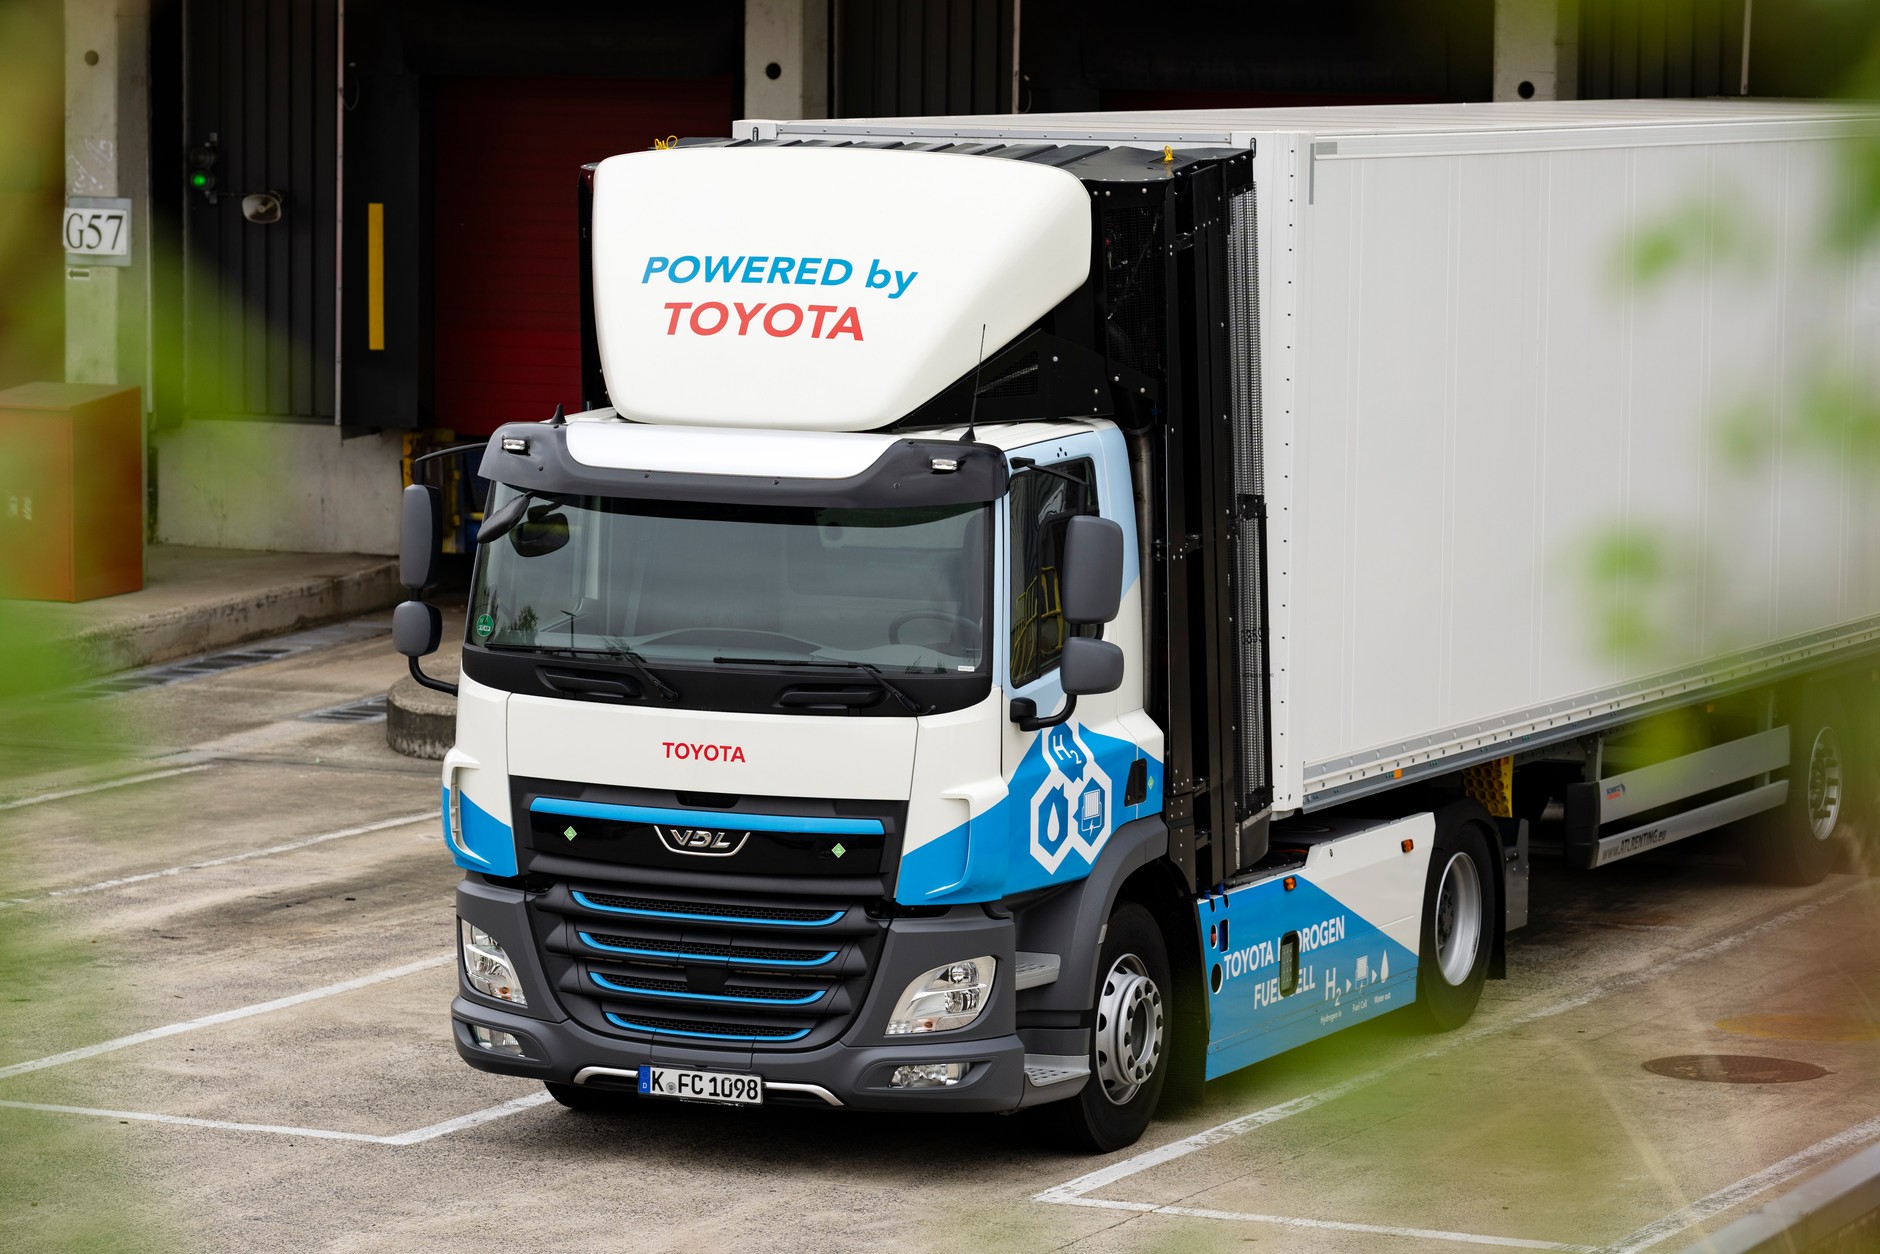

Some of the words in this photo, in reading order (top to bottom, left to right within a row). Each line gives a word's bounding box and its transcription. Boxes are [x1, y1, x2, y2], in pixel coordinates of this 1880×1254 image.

[66, 212, 123, 250] G57
[642, 255, 853, 286] POWERED
[865, 258, 918, 299] by
[663, 301, 864, 341] TOYOTA
[662, 741, 746, 763] TOYOTA
[670, 828, 731, 849] VDL
[1223, 940, 1274, 980] TOYOTA
[652, 1070, 664, 1092] K
[678, 1073, 704, 1095] FC
[708, 1076, 758, 1101] 1098
